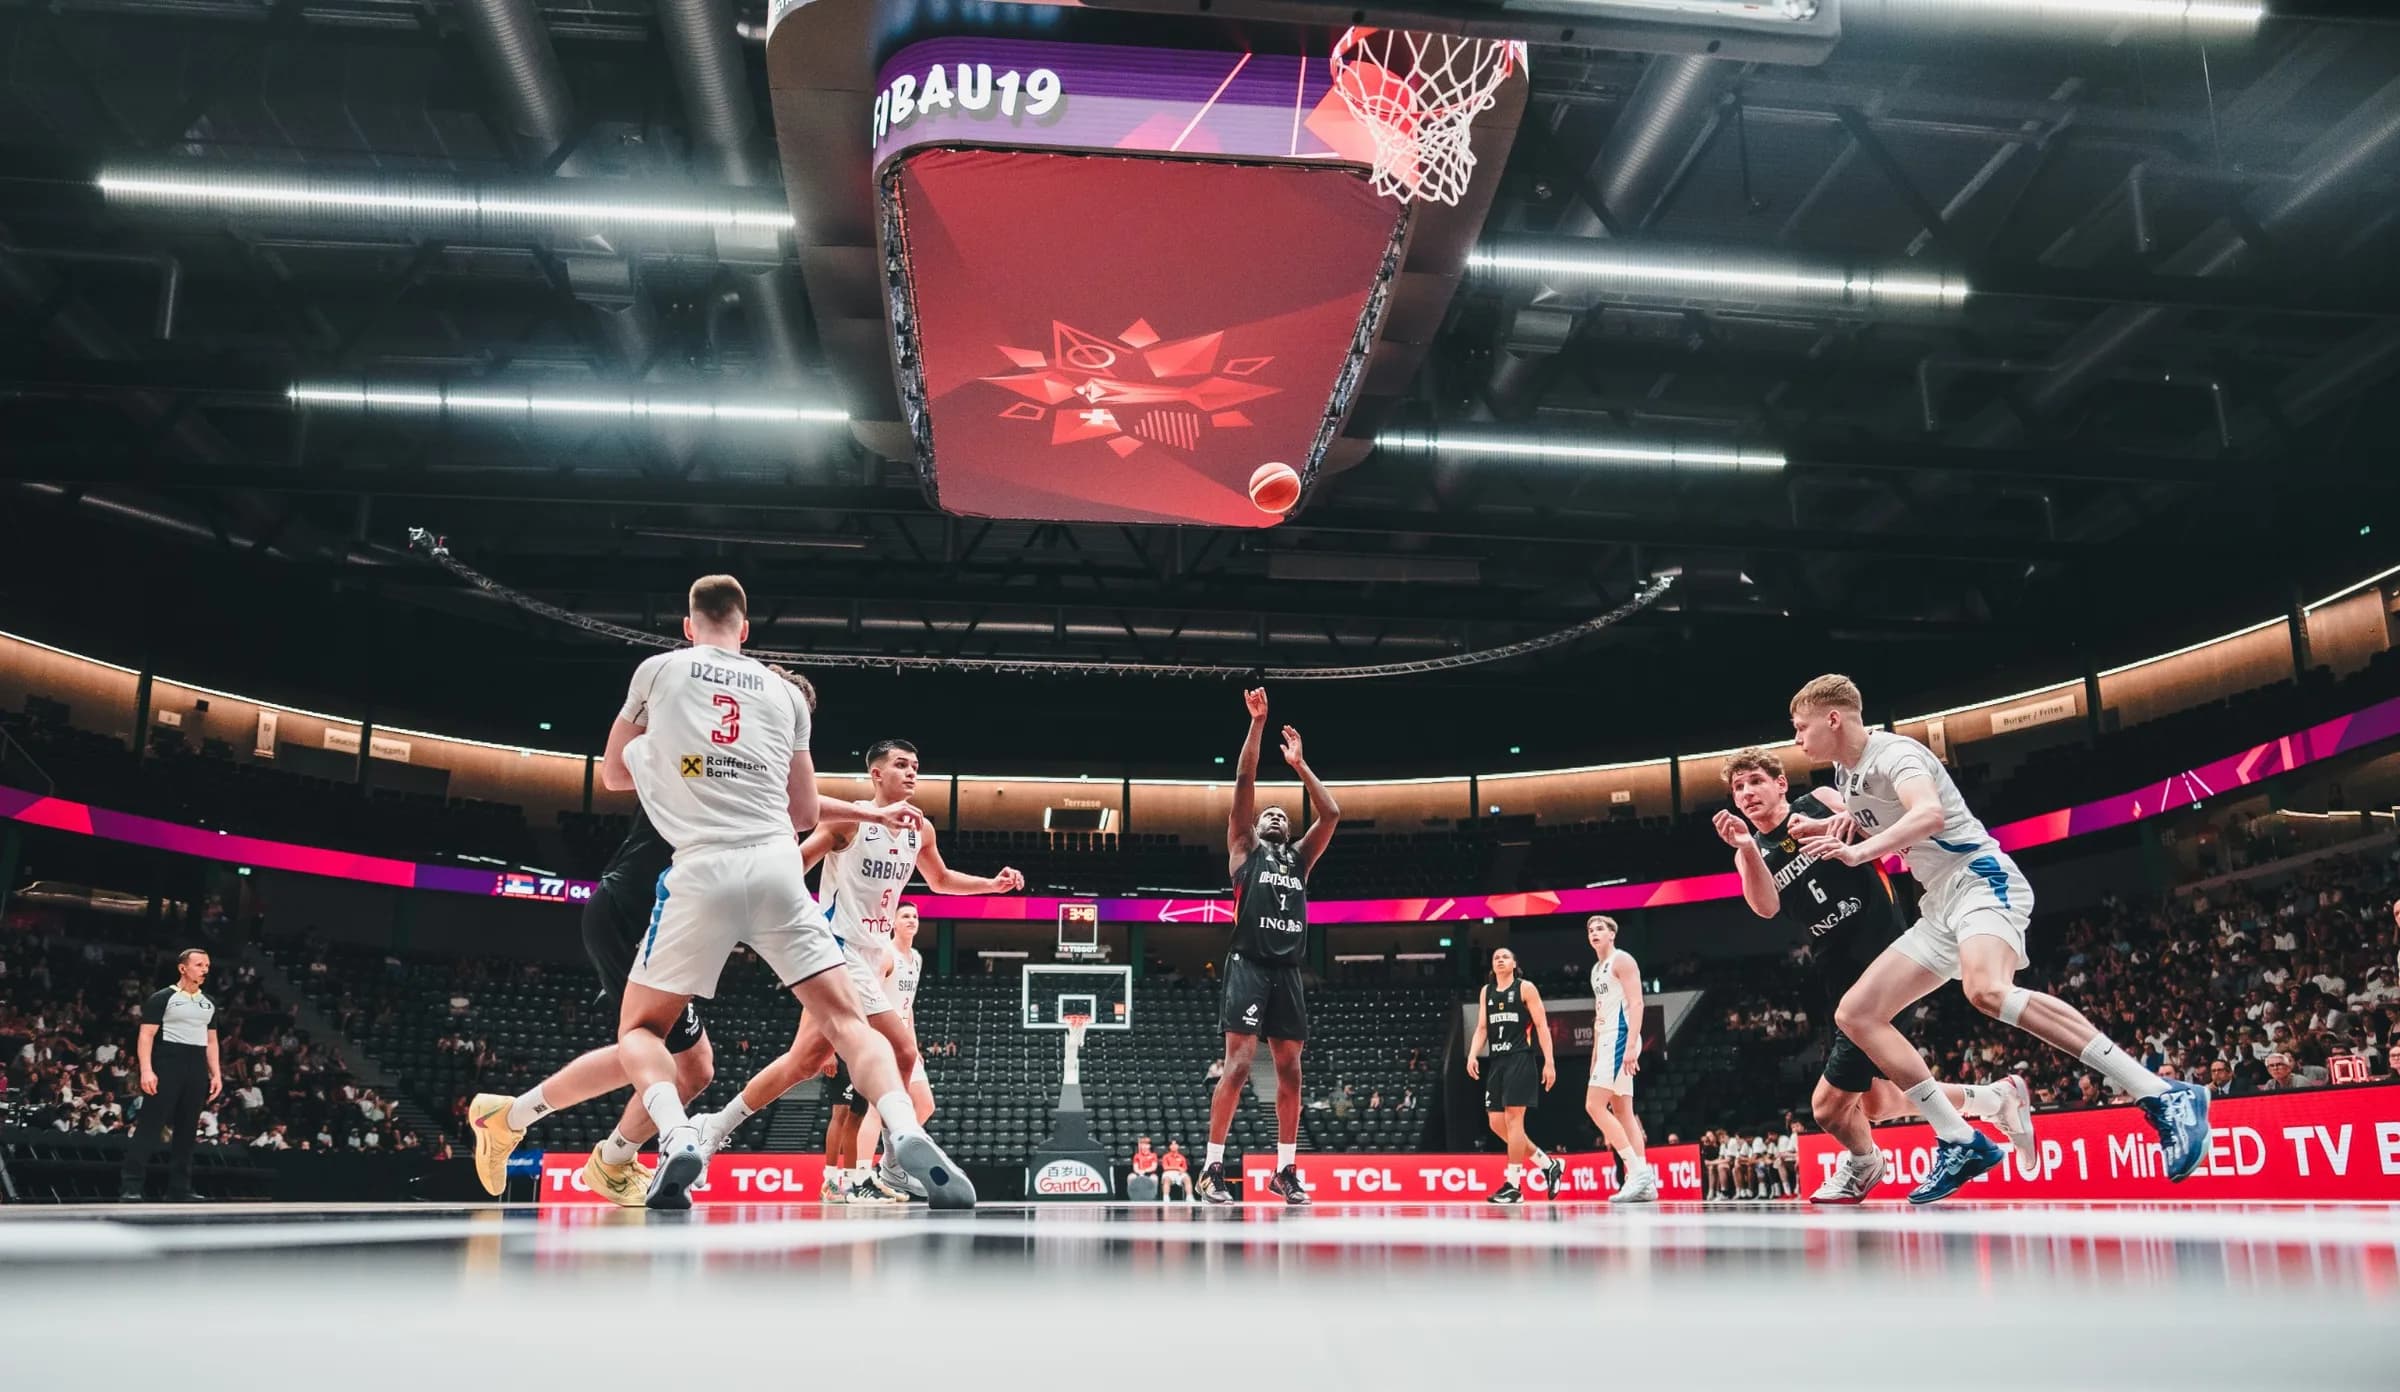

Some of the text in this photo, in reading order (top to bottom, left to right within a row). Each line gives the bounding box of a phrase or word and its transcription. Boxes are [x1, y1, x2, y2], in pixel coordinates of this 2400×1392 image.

[711, 694, 740, 744] 3
[706, 755, 768, 772] Raiffeisen
[706, 767, 739, 779] Bank
[1063, 798, 1102, 808] Terrasse
[540, 878, 565, 896] 77
[570, 886, 591, 899] Q4
[1807, 878, 1828, 905] 6
[881, 889, 893, 908] 5
[1259, 917, 1286, 931] ING
[1809, 912, 1840, 937] ING
[2072, 1138, 2089, 1181] 1
[2283, 1124, 2353, 1176] TV
[731, 1167, 803, 1192] TCL
[1048, 1166, 1087, 1177] 百岁山
[1333, 1168, 1402, 1192] TCL
[1419, 1168, 1488, 1192] TCL
[1572, 1167, 1598, 1191] TCL
[1669, 1160, 1700, 1188] TCL
